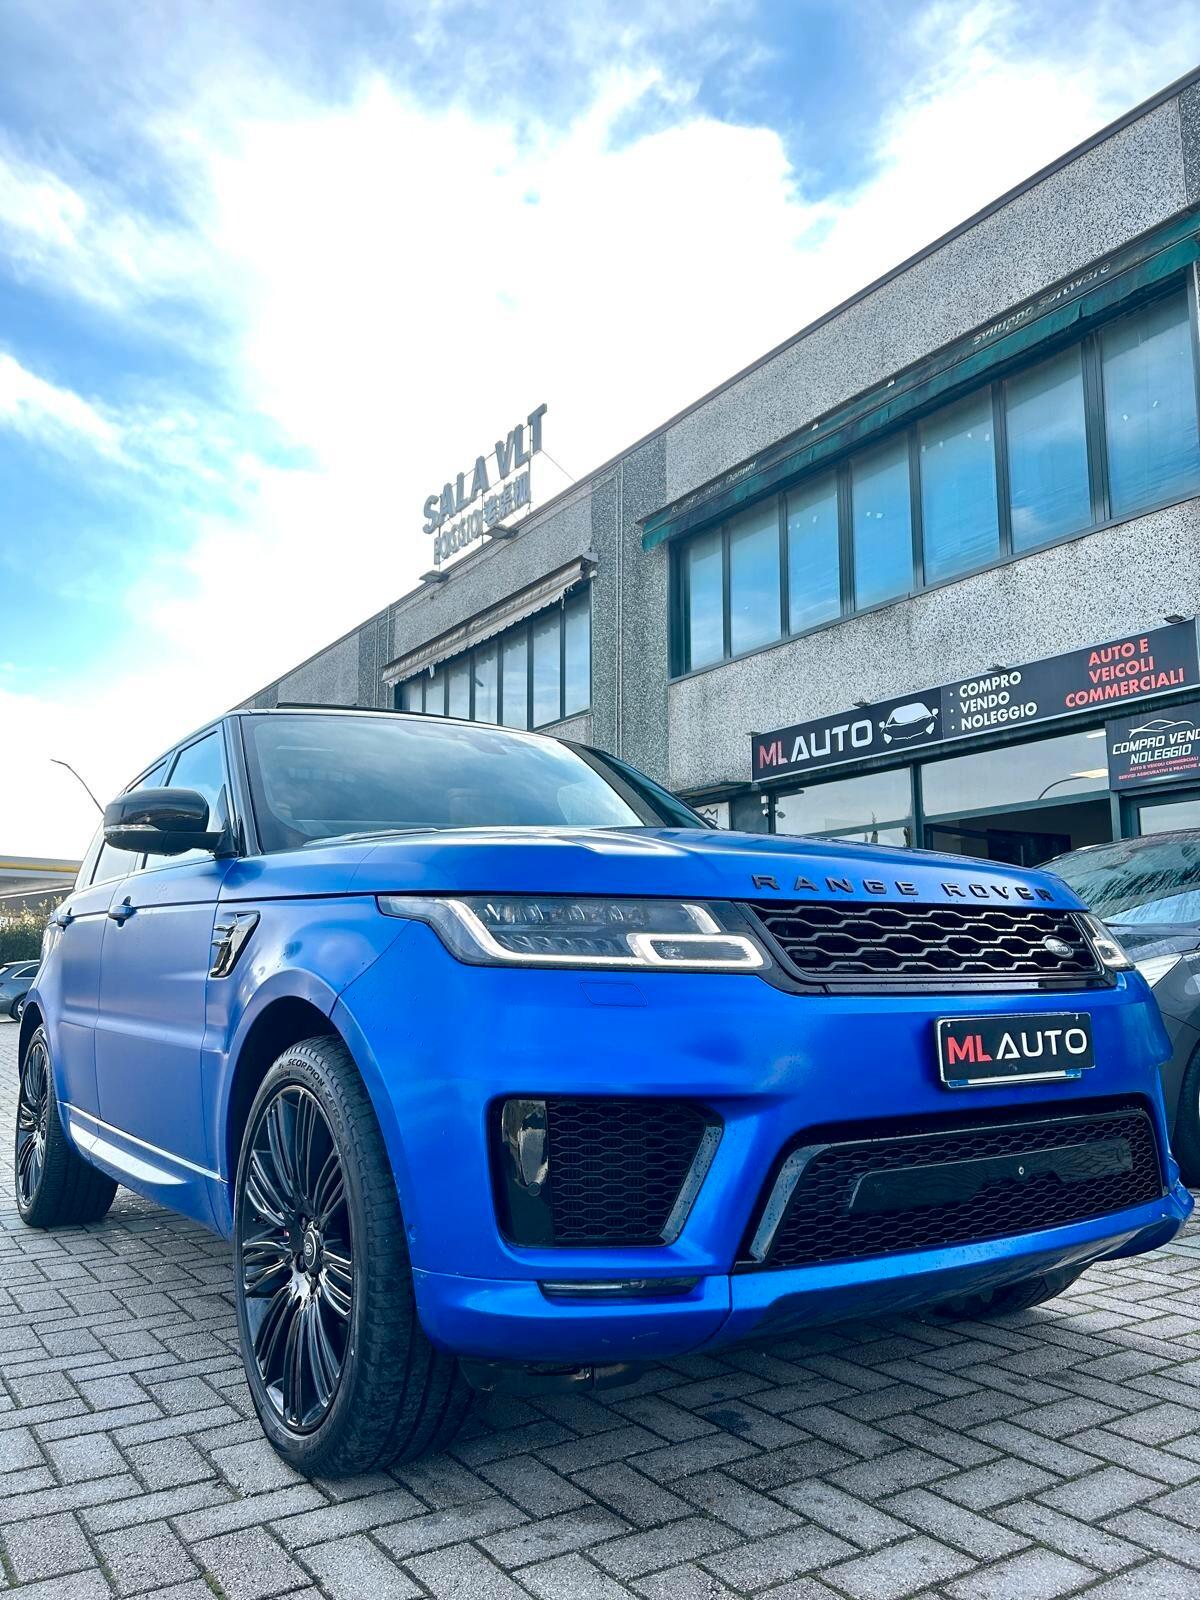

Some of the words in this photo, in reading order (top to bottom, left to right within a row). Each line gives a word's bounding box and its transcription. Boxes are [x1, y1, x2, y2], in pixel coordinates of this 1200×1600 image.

[423, 456, 491, 534] SALA
[495, 403, 548, 480] VLT
[1088, 641, 1135, 667] AUTO
[1139, 638, 1149, 655] E
[1089, 655, 1155, 684] VEICOLI
[958, 671, 1022, 698] COMPRO
[1065, 668, 1185, 708] COMMERCIALI
[959, 691, 1010, 715] VENDO
[960, 701, 1038, 731] NOLEGGIO
[758, 740, 788, 769] ML
[790, 719, 873, 763] AUTO
[1112, 736, 1165, 755] COMPRO
[1130, 744, 1191, 765] NOLEGGIO
[752, 873, 919, 896] RANGE
[941, 881, 1054, 901] ROVER
[947, 1034, 993, 1065] ML
[995, 1028, 1088, 1060] AUTO
[287, 1059, 325, 1087] SCORPION
[324, 1090, 345, 1134] ZERO
